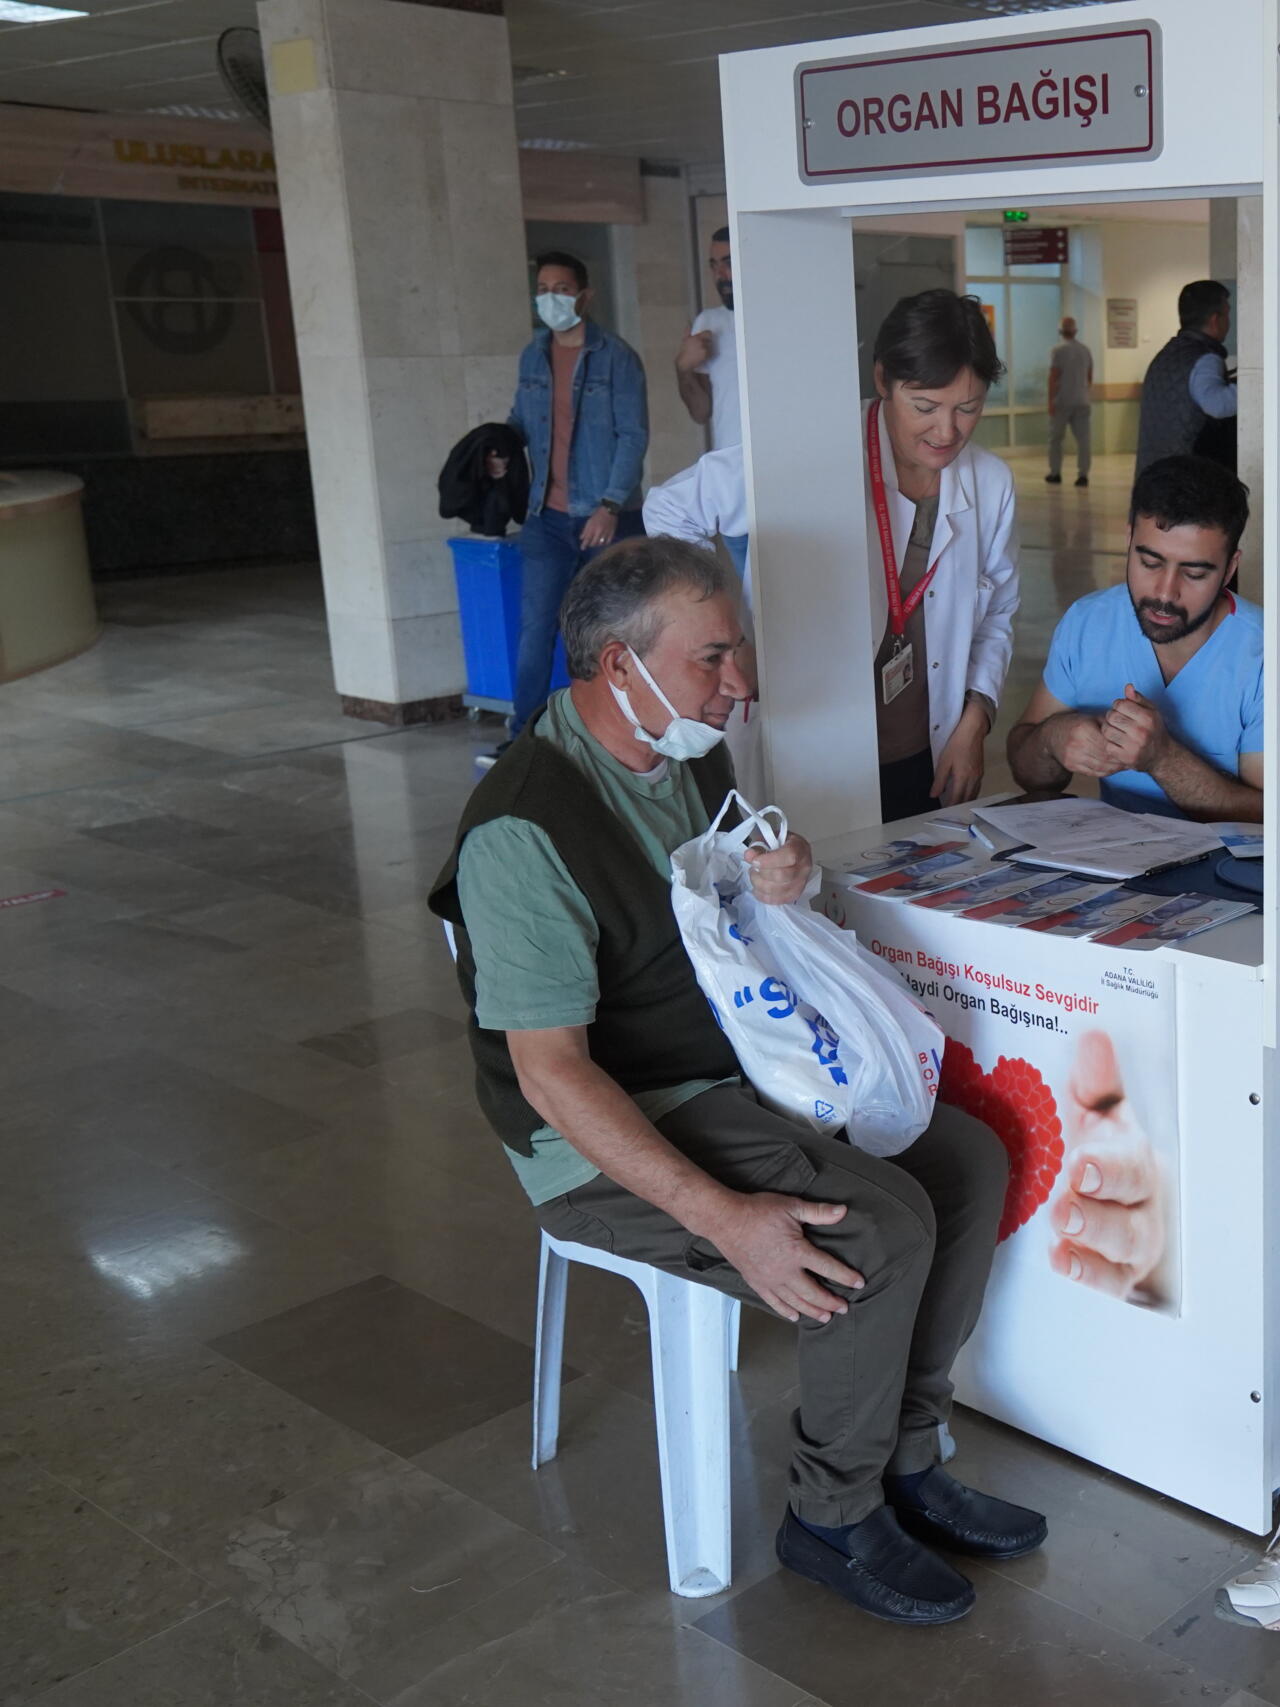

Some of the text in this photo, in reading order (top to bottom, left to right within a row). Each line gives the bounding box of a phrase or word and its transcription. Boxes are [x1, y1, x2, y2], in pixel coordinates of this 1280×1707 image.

[837, 68, 1110, 138] ORGAN BAĞIŞI
[871, 939, 1100, 1015] Organ Bağışı Koşulsuz Sevgidir
[1104, 970, 1127, 982] ADANA
[1106, 979, 1124, 991] Sağlık
[1125, 984, 1159, 1000] Müdürlüğü
[943, 984, 986, 1013] Organ
[991, 999, 1069, 1036] Bağışına!..
